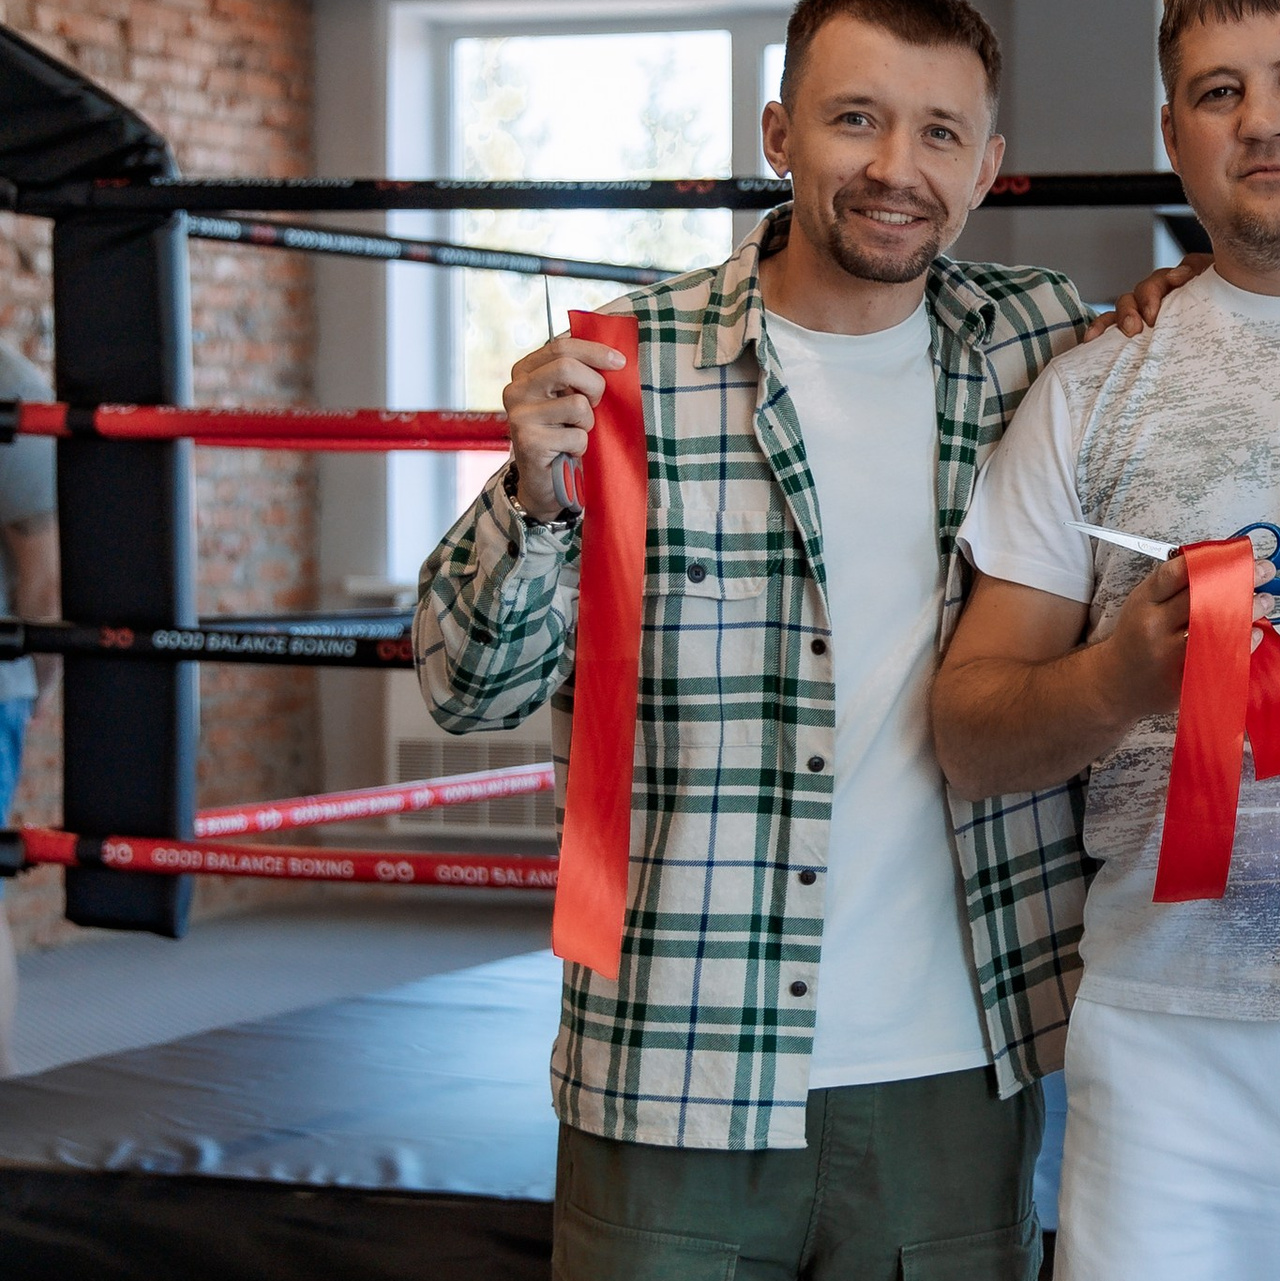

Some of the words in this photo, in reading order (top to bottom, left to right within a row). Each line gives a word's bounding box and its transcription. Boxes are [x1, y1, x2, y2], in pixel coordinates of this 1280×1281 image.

[151, 629, 204, 650] GOOD
[205, 632, 287, 655] BALANCE
[289, 637, 357, 658] BOXING
[151, 846, 203, 868] GOOD
[205, 851, 284, 872] BALANCE
[287, 856, 355, 878] BOXING
[434, 863, 489, 884] GOOD
[492, 867, 559, 888] BALAN
